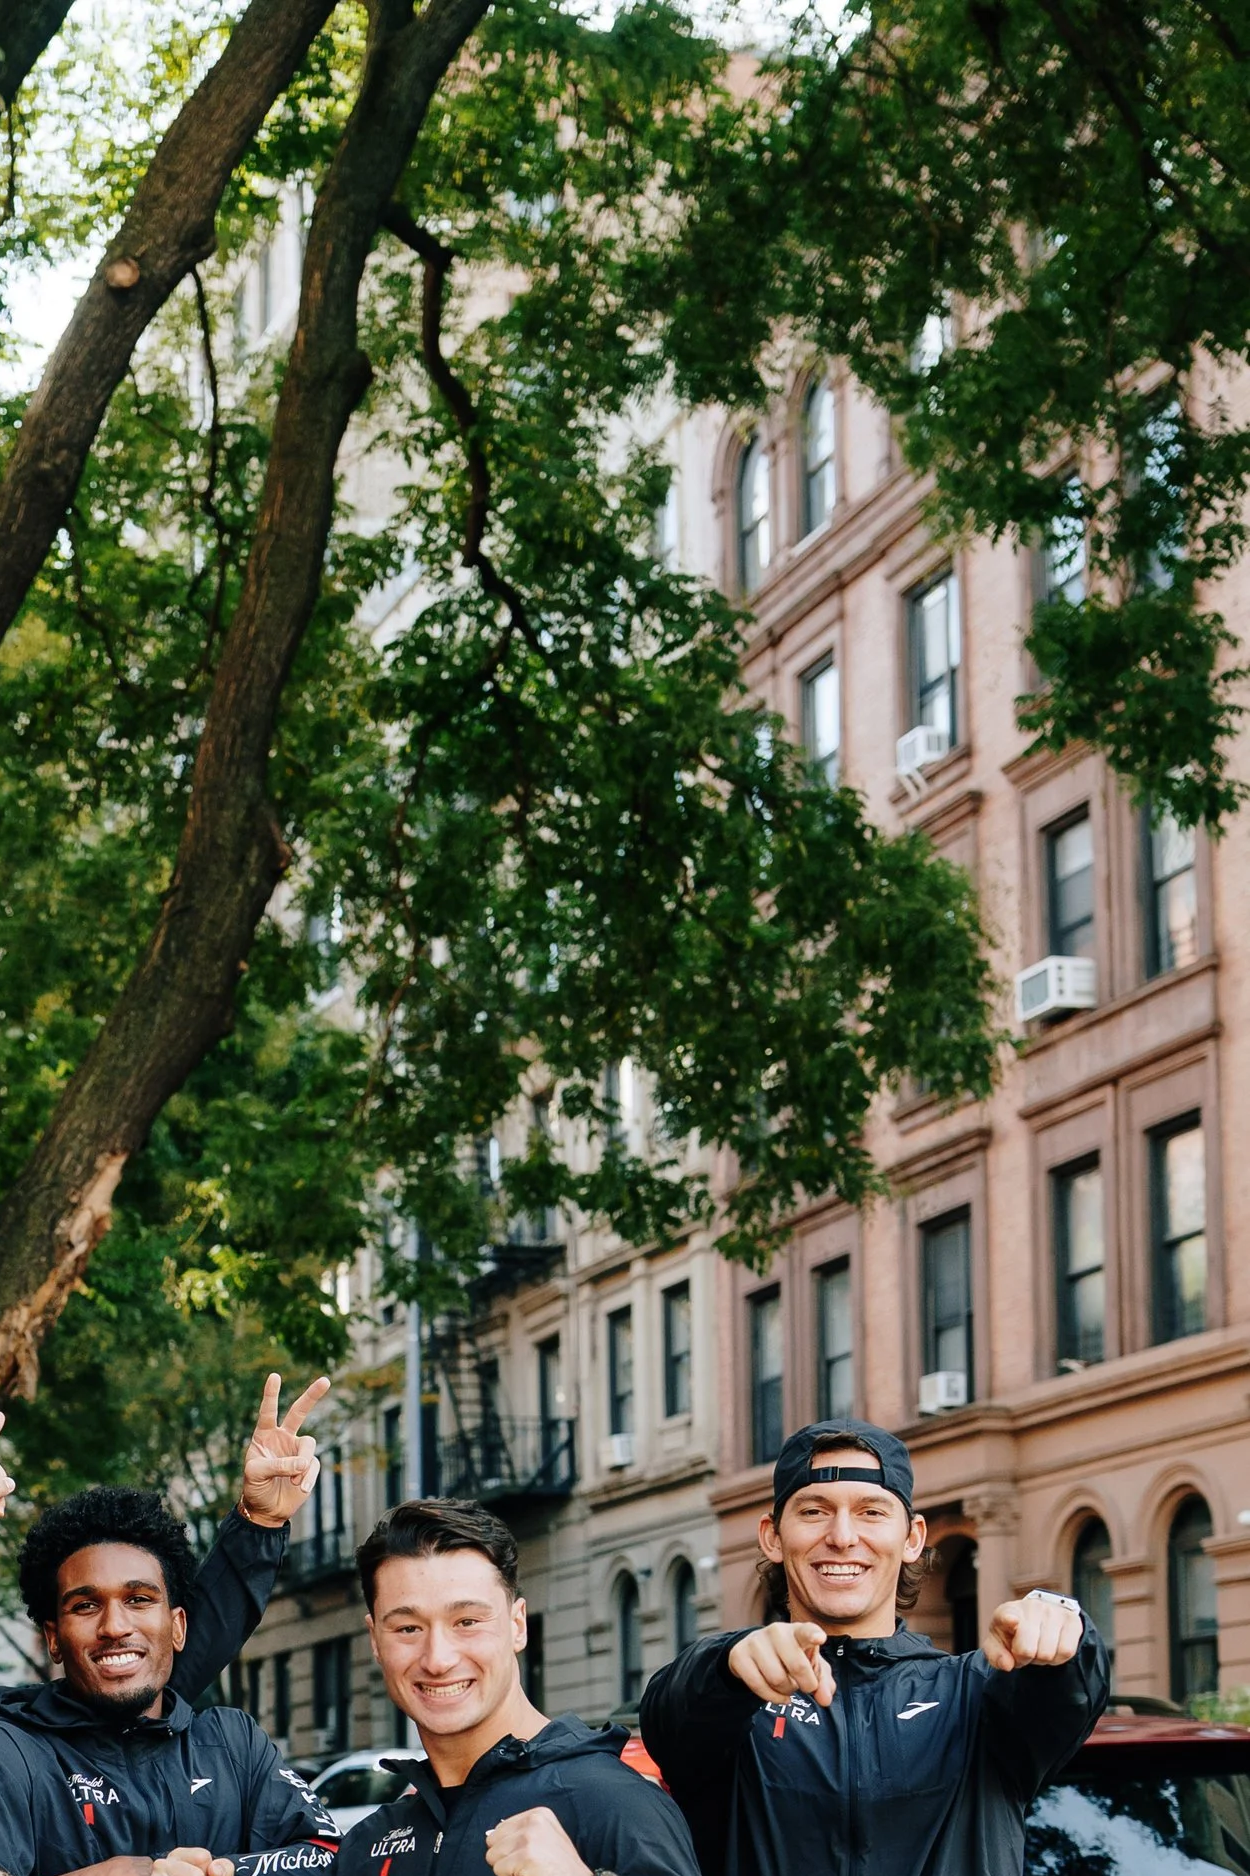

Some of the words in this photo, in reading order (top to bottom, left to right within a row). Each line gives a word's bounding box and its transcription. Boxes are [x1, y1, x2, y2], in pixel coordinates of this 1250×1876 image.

[764, 1701, 821, 1726] LTRA
[71, 1786, 120, 1806] LTRA
[369, 1836, 416, 1858] ULTRA
